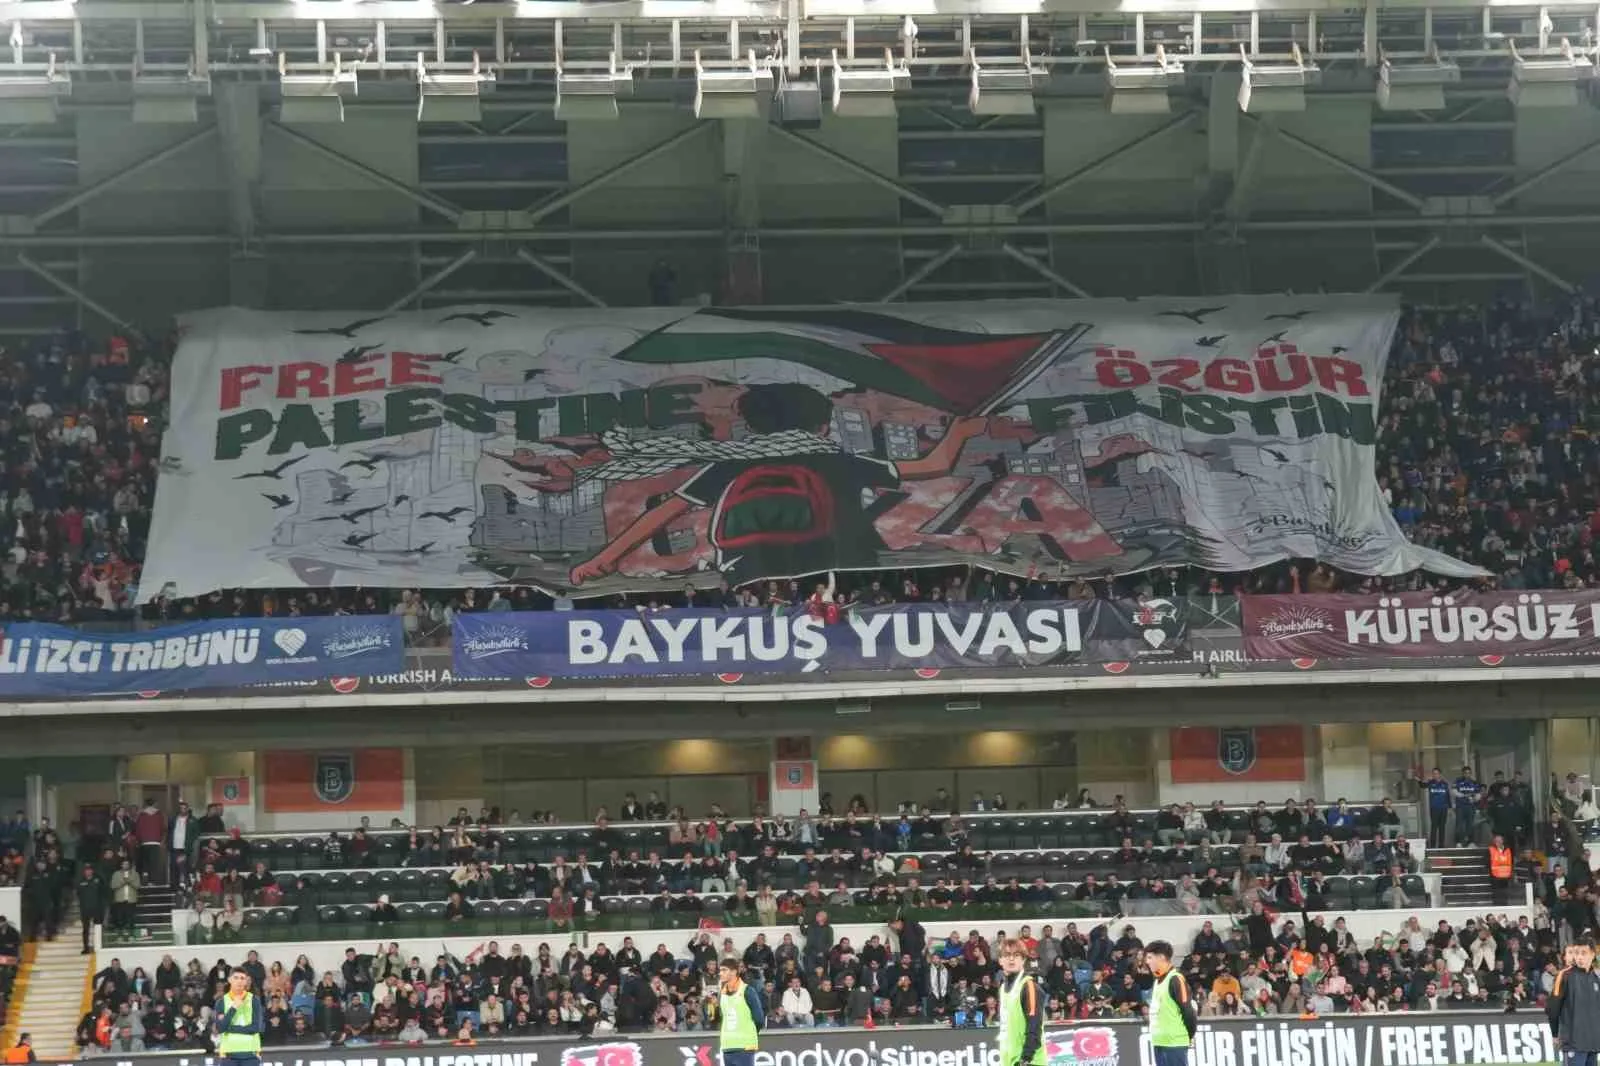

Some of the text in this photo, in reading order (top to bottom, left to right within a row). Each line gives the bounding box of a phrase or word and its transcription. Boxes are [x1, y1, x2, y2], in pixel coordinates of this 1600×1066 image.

[219, 351, 443, 411] FREE
[1095, 344, 1371, 397] ÖZGÜR
[215, 383, 706, 460] PALESTINE
[568, 607, 1082, 673] BAYKUŞ YUVASI
[1344, 593, 1580, 644] KÜFÜRSÜZ
[1139, 1024, 1238, 1066] ÖÜR
[1242, 1021, 1358, 1066] FİLİSTİN
[1380, 1027, 1449, 1066] FREE
[1453, 1023, 1563, 1064] PALEST
